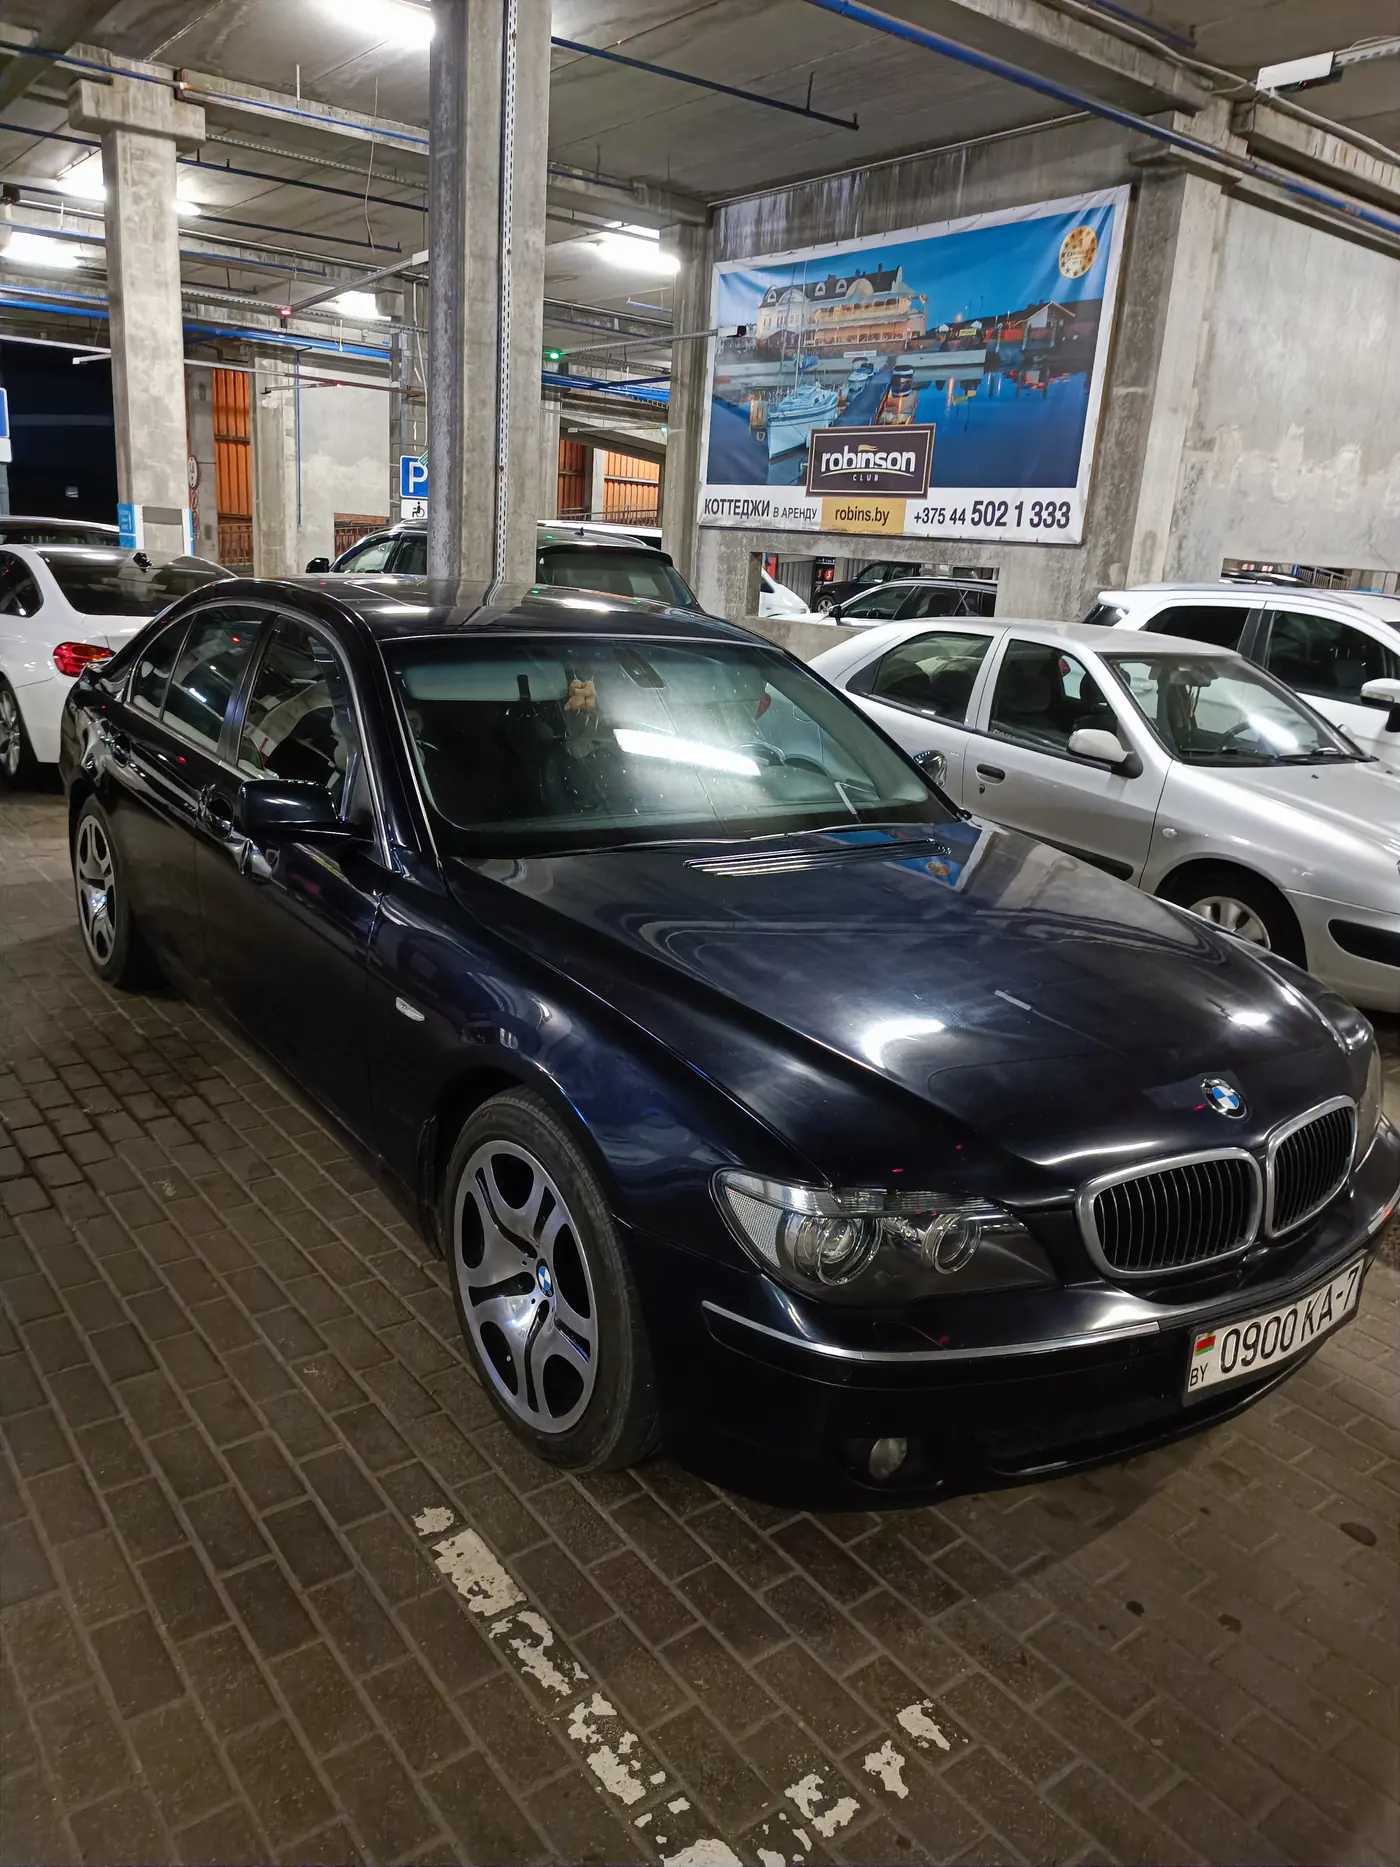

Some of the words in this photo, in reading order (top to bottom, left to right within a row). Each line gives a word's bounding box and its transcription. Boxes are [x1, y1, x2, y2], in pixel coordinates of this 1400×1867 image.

[820, 444, 916, 472] robinson
[408, 461, 428, 493] P
[852, 474, 879, 482] CLUB
[704, 498, 770, 519] КОТТЕДЖИ
[781, 507, 818, 521] АРЕНДУ
[835, 506, 890, 526] robins.by
[914, 507, 946, 524] +375
[949, 508, 966, 525] 44
[970, 500, 1009, 527] 502
[1014, 501, 1024, 527] 1
[1029, 501, 1071, 529] 333
[1190, 1362, 1209, 1387] BY
